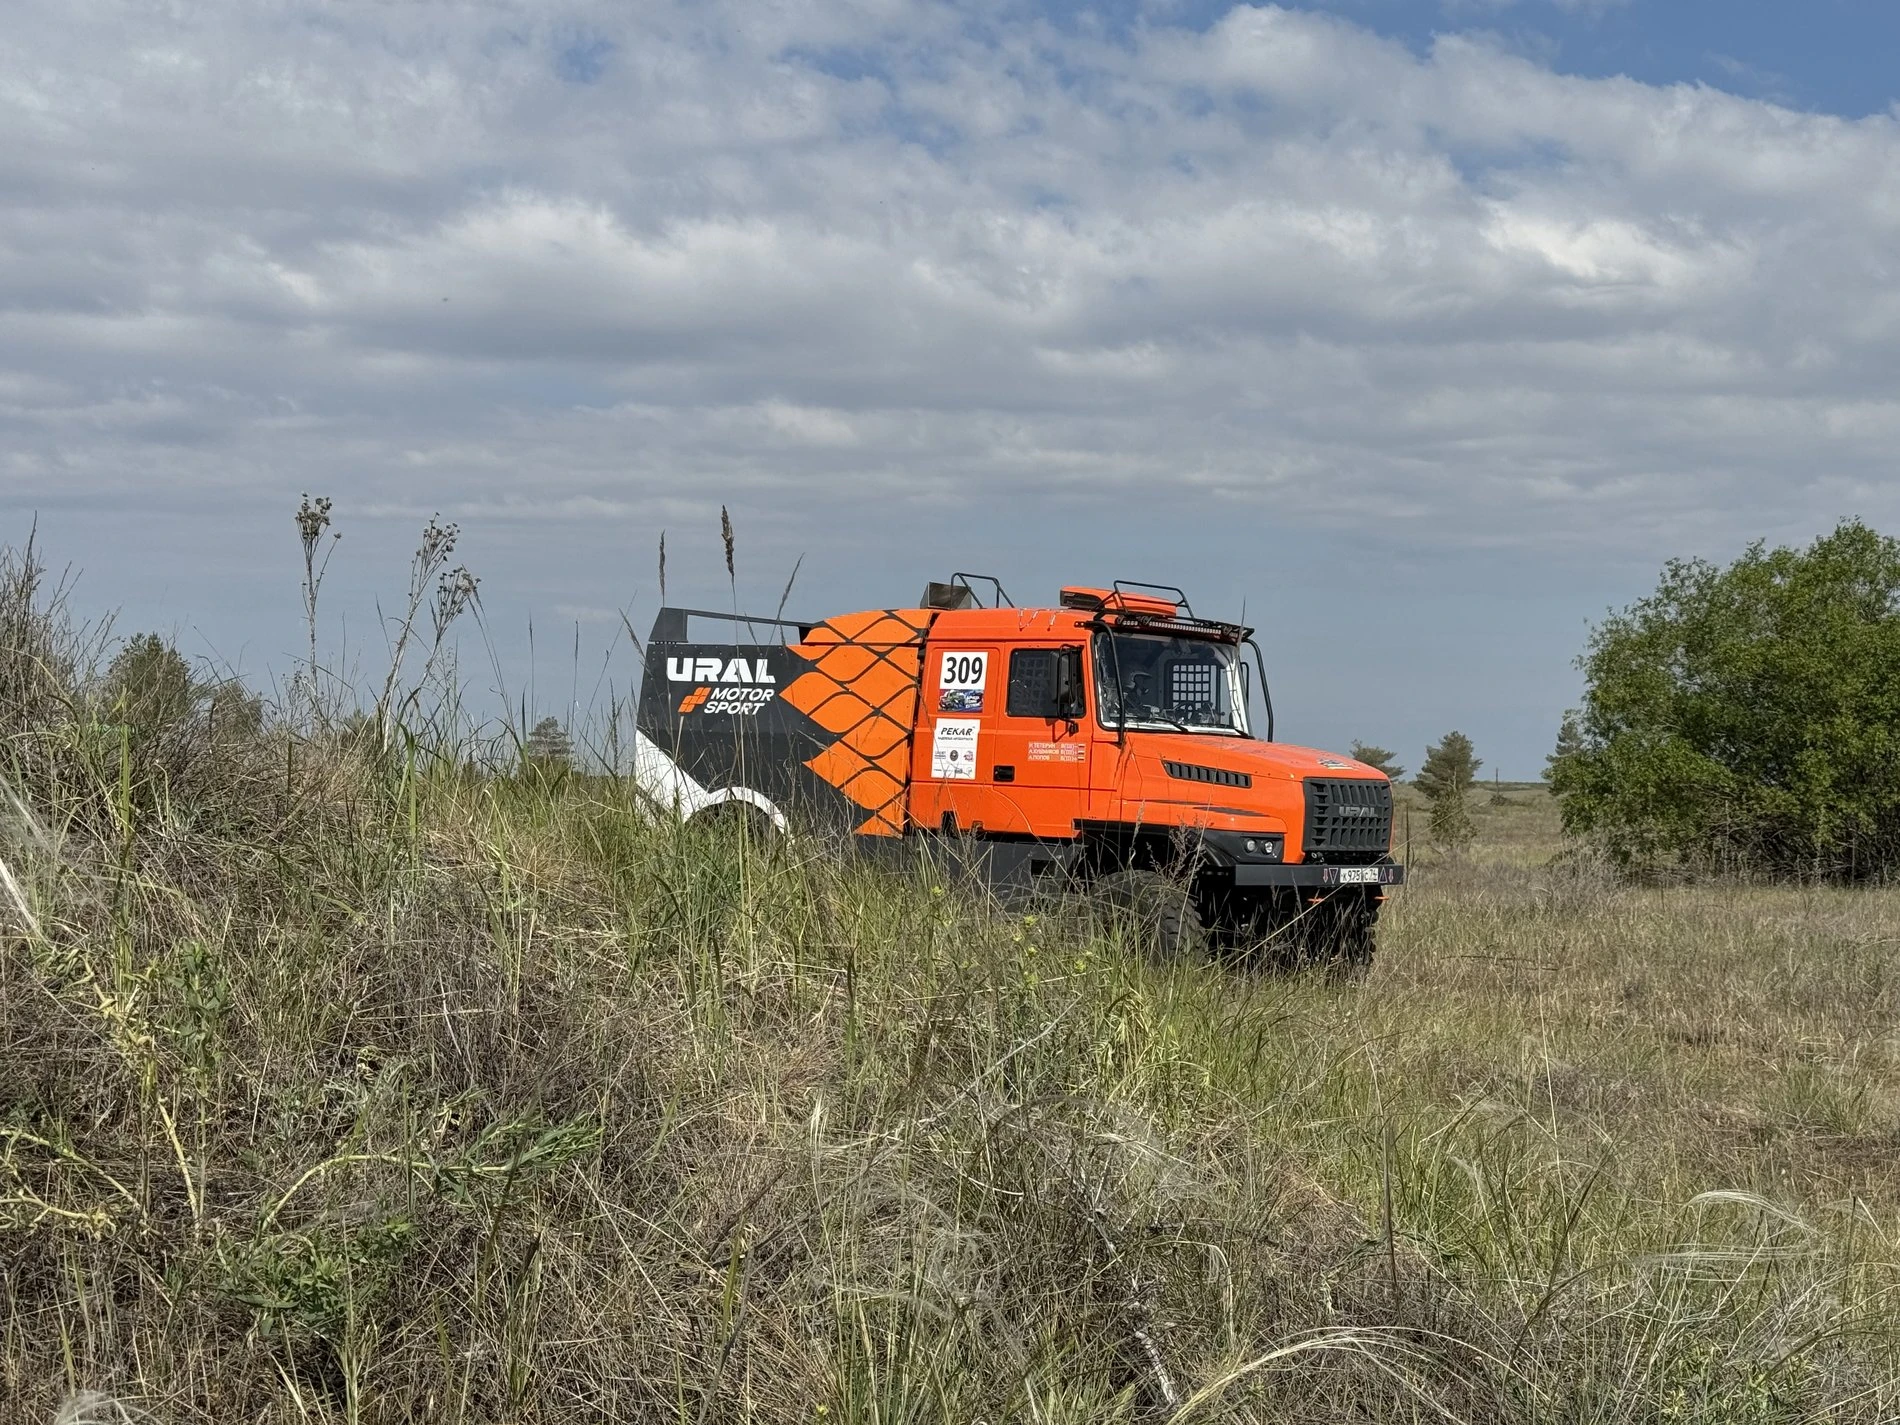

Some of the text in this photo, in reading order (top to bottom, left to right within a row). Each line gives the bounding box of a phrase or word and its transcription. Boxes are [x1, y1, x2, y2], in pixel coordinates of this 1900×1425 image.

[667, 657, 776, 683] URAL
[944, 656, 983, 684] 309
[711, 687, 774, 701] MOTOR
[704, 701, 765, 714] SPORT
[940, 727, 973, 736] PEKAR
[1339, 806, 1378, 818] URAL
